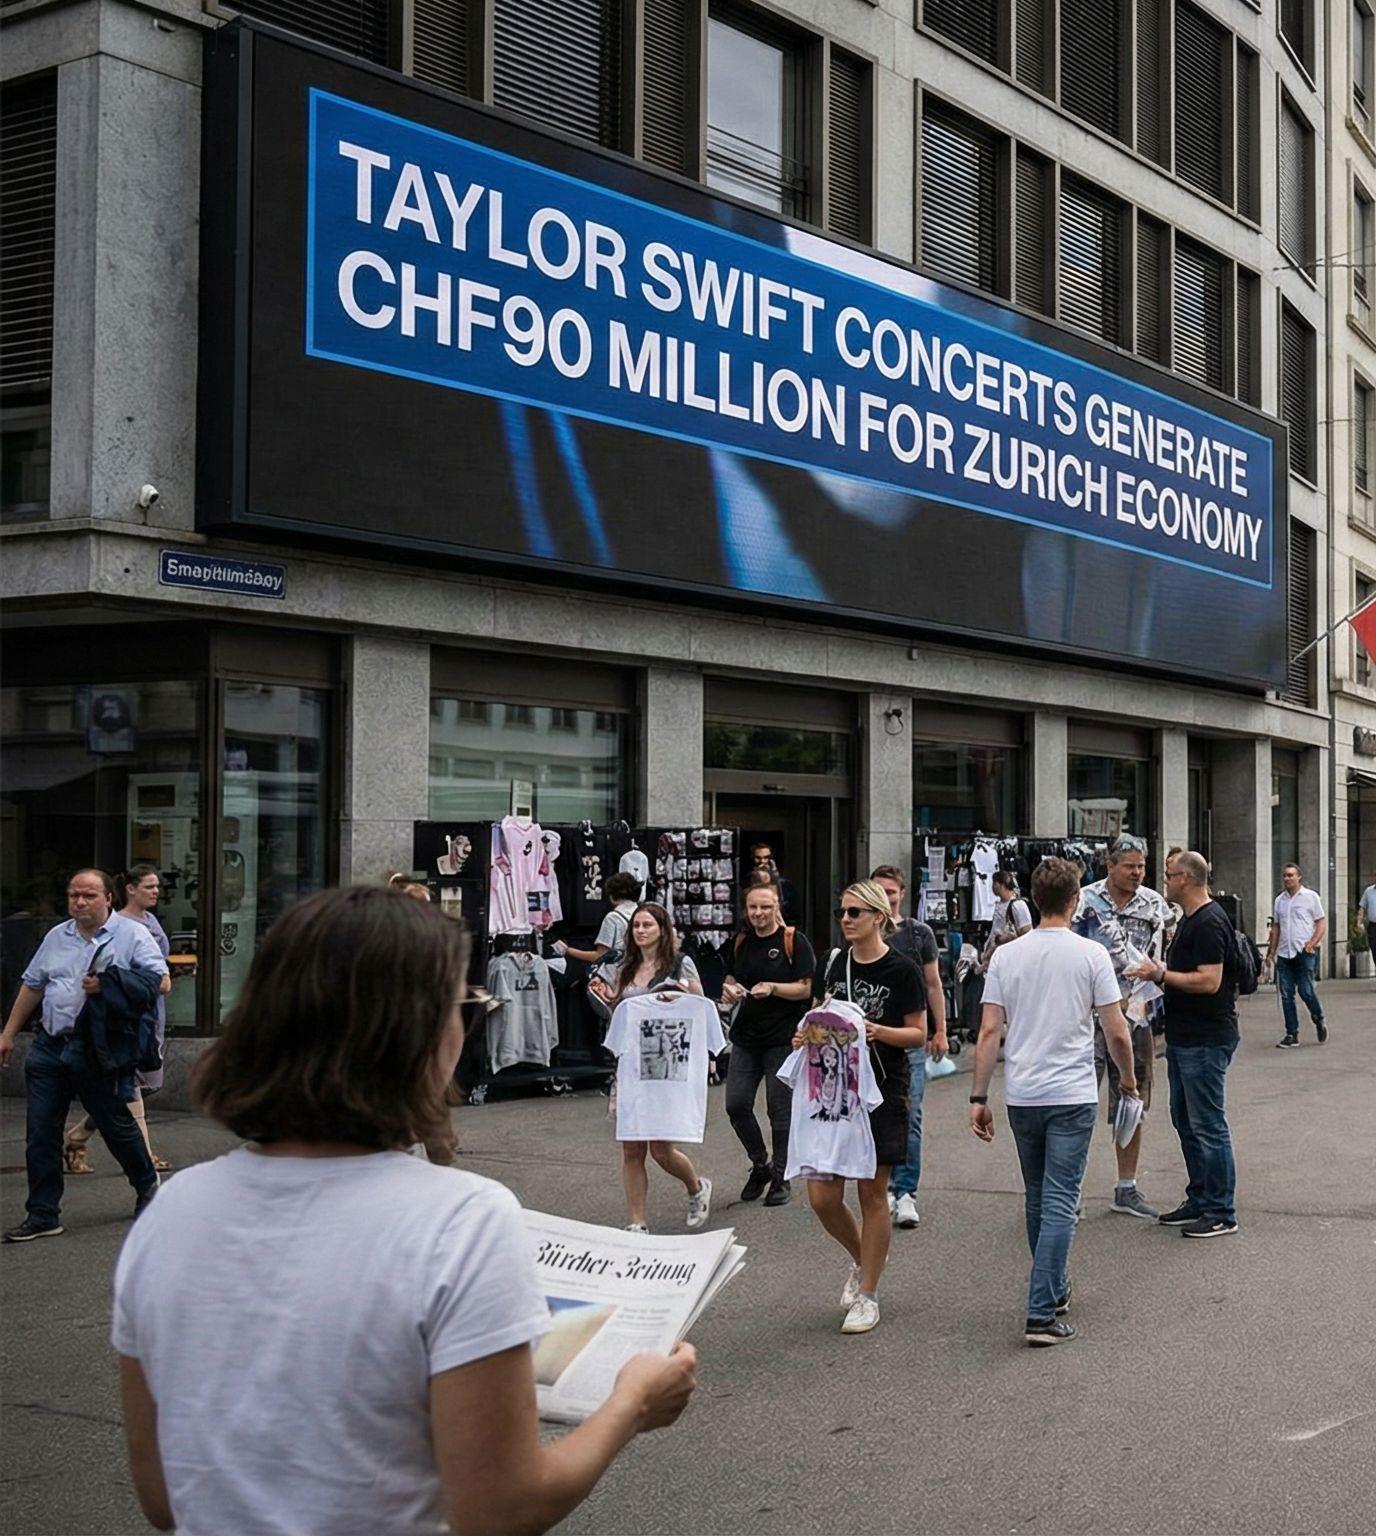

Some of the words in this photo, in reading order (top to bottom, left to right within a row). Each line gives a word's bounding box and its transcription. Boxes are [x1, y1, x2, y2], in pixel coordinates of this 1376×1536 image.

[337, 140, 627, 299] TAYLOR
[641, 241, 826, 355] SWIFT
[834, 306, 1078, 436] CONCERTS
[1085, 392, 1249, 499] GENERATE
[337, 250, 593, 379] CHF90
[608, 323, 847, 446] MILLION
[857, 394, 955, 475] FOR
[963, 422, 1107, 515] ZURICH
[1114, 470, 1263, 562] ECONOMY
[614, 1256, 697, 1287] Zeitung
